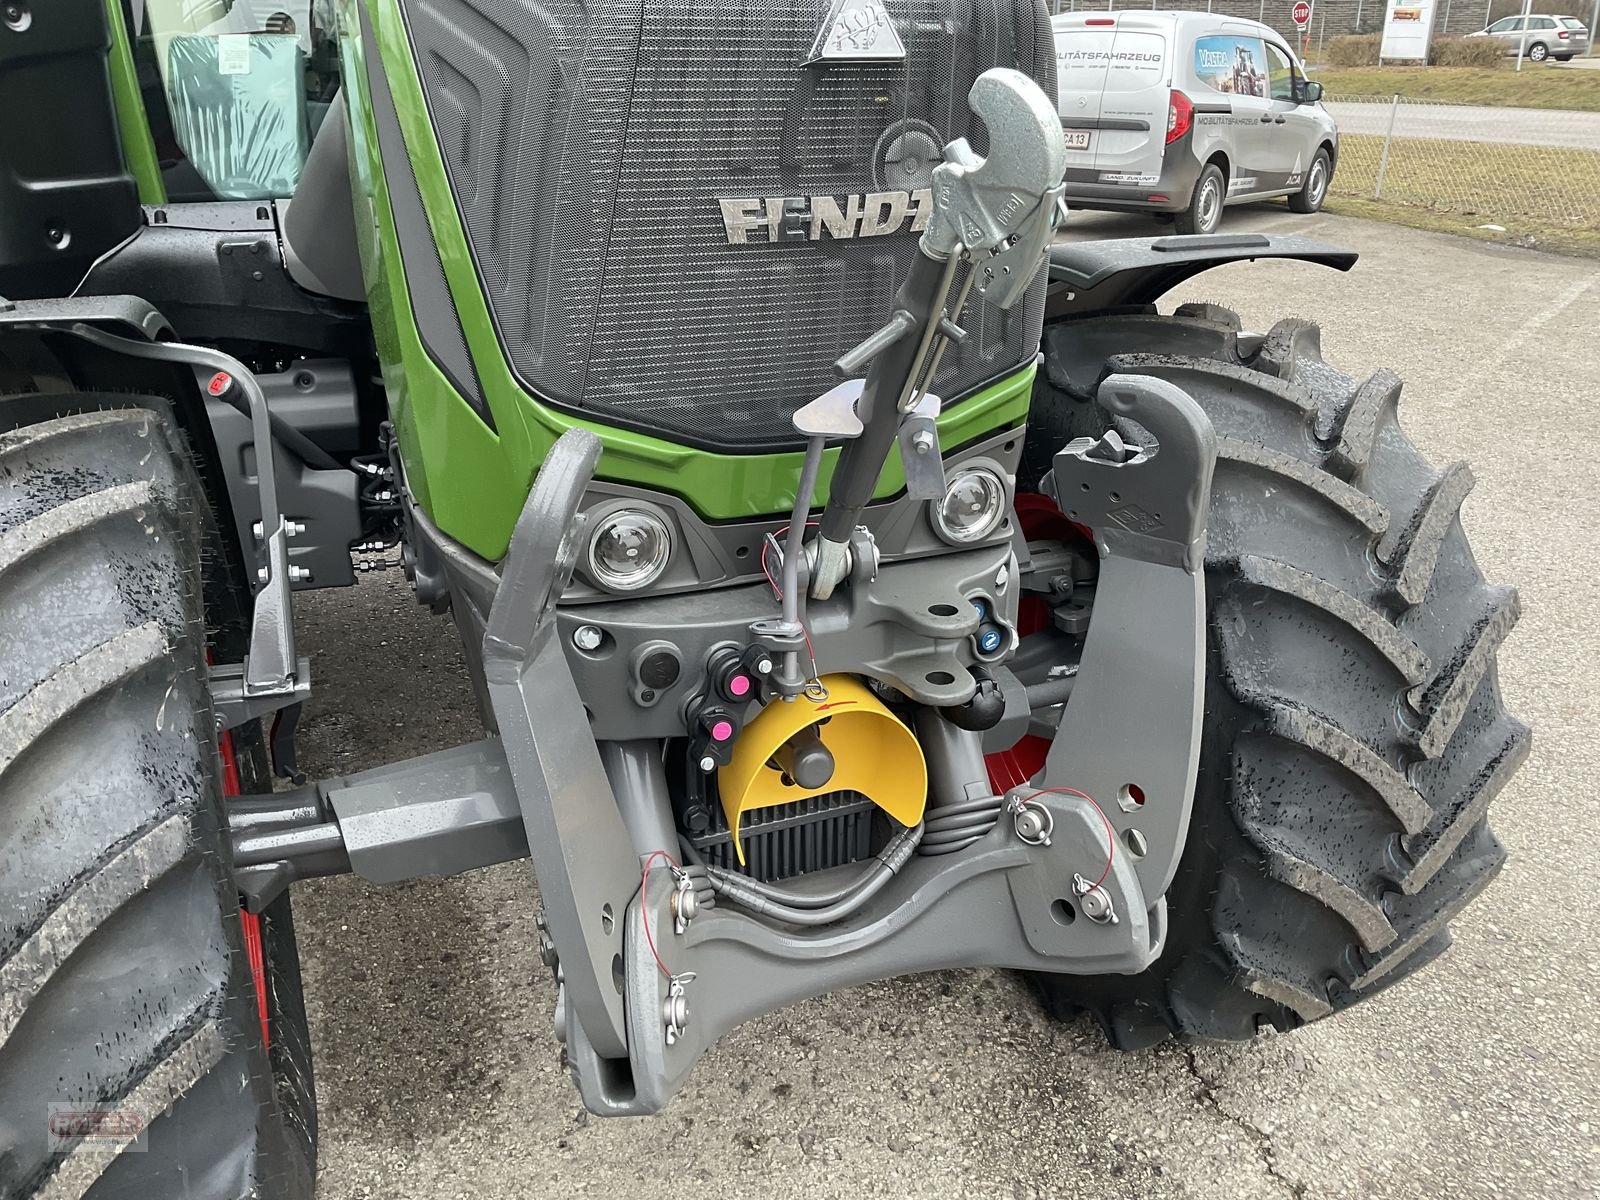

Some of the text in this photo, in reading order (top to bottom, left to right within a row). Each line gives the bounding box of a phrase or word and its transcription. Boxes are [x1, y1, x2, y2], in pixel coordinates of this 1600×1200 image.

[1294, 8, 1308, 18] STOP
[1076, 134, 1085, 145] 13
[1285, 174, 1301, 185] ACA
